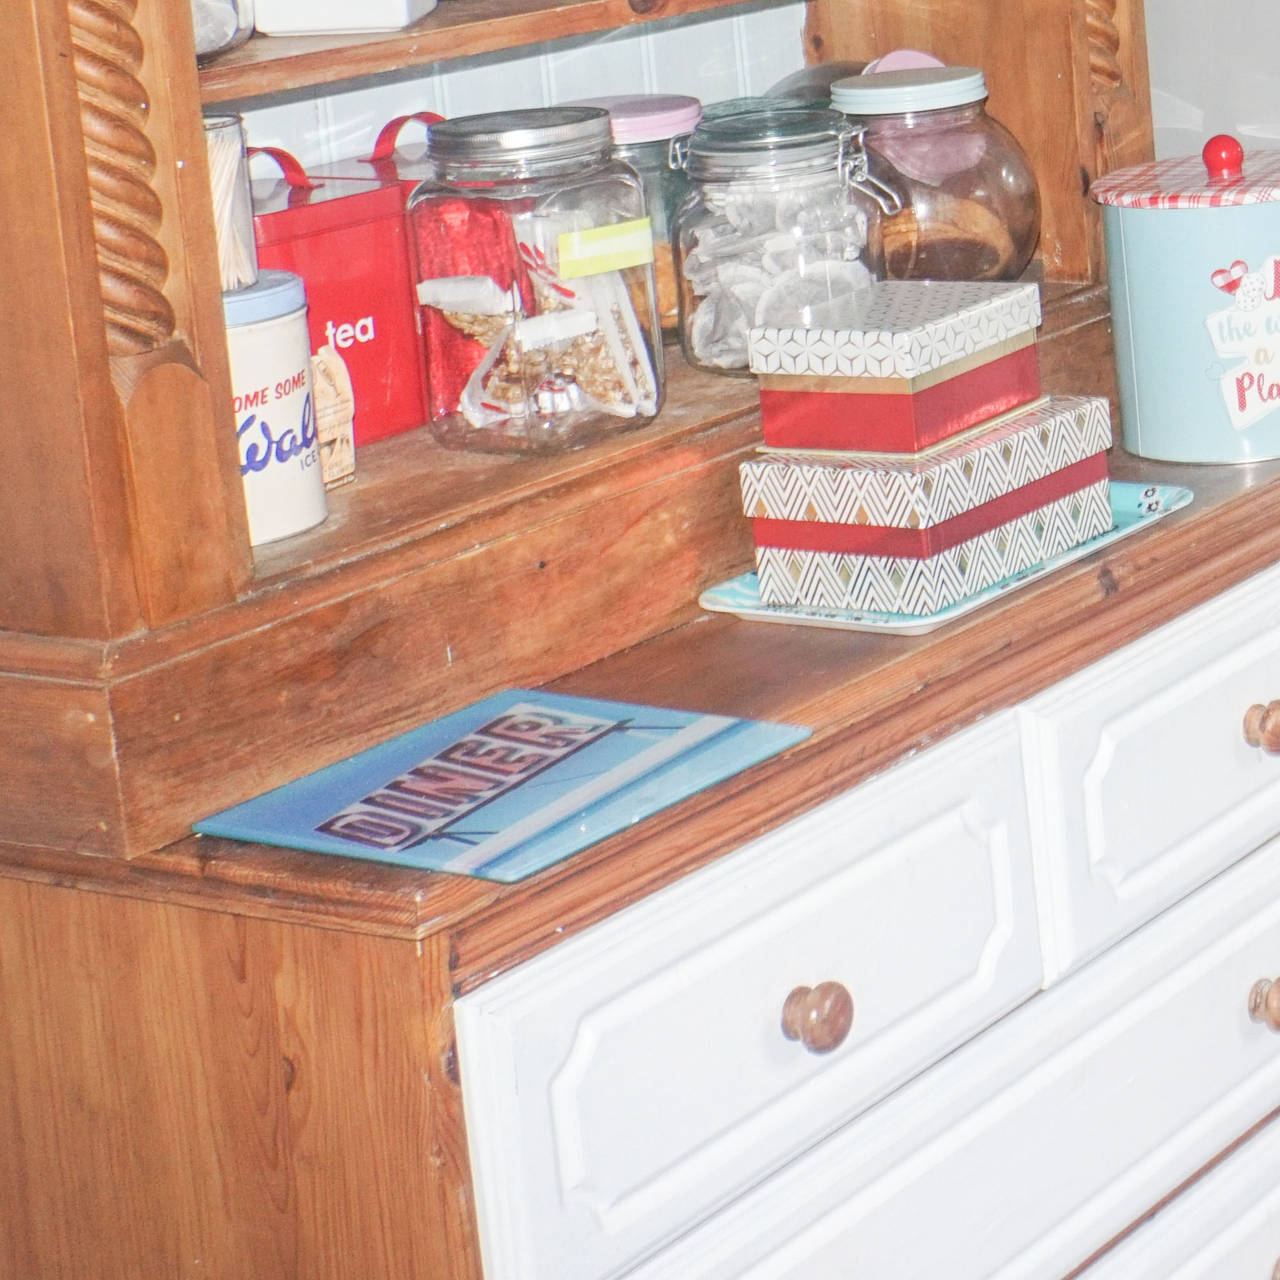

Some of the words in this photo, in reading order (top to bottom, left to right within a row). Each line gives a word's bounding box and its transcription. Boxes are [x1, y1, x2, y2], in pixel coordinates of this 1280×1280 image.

[325, 316, 375, 350] tea
[1217, 314, 1257, 345] the
[1252, 346, 1275, 366] a
[274, 368, 306, 400] SOME
[300, 450, 318, 472] ICE
[314, 711, 602, 850] DINER
